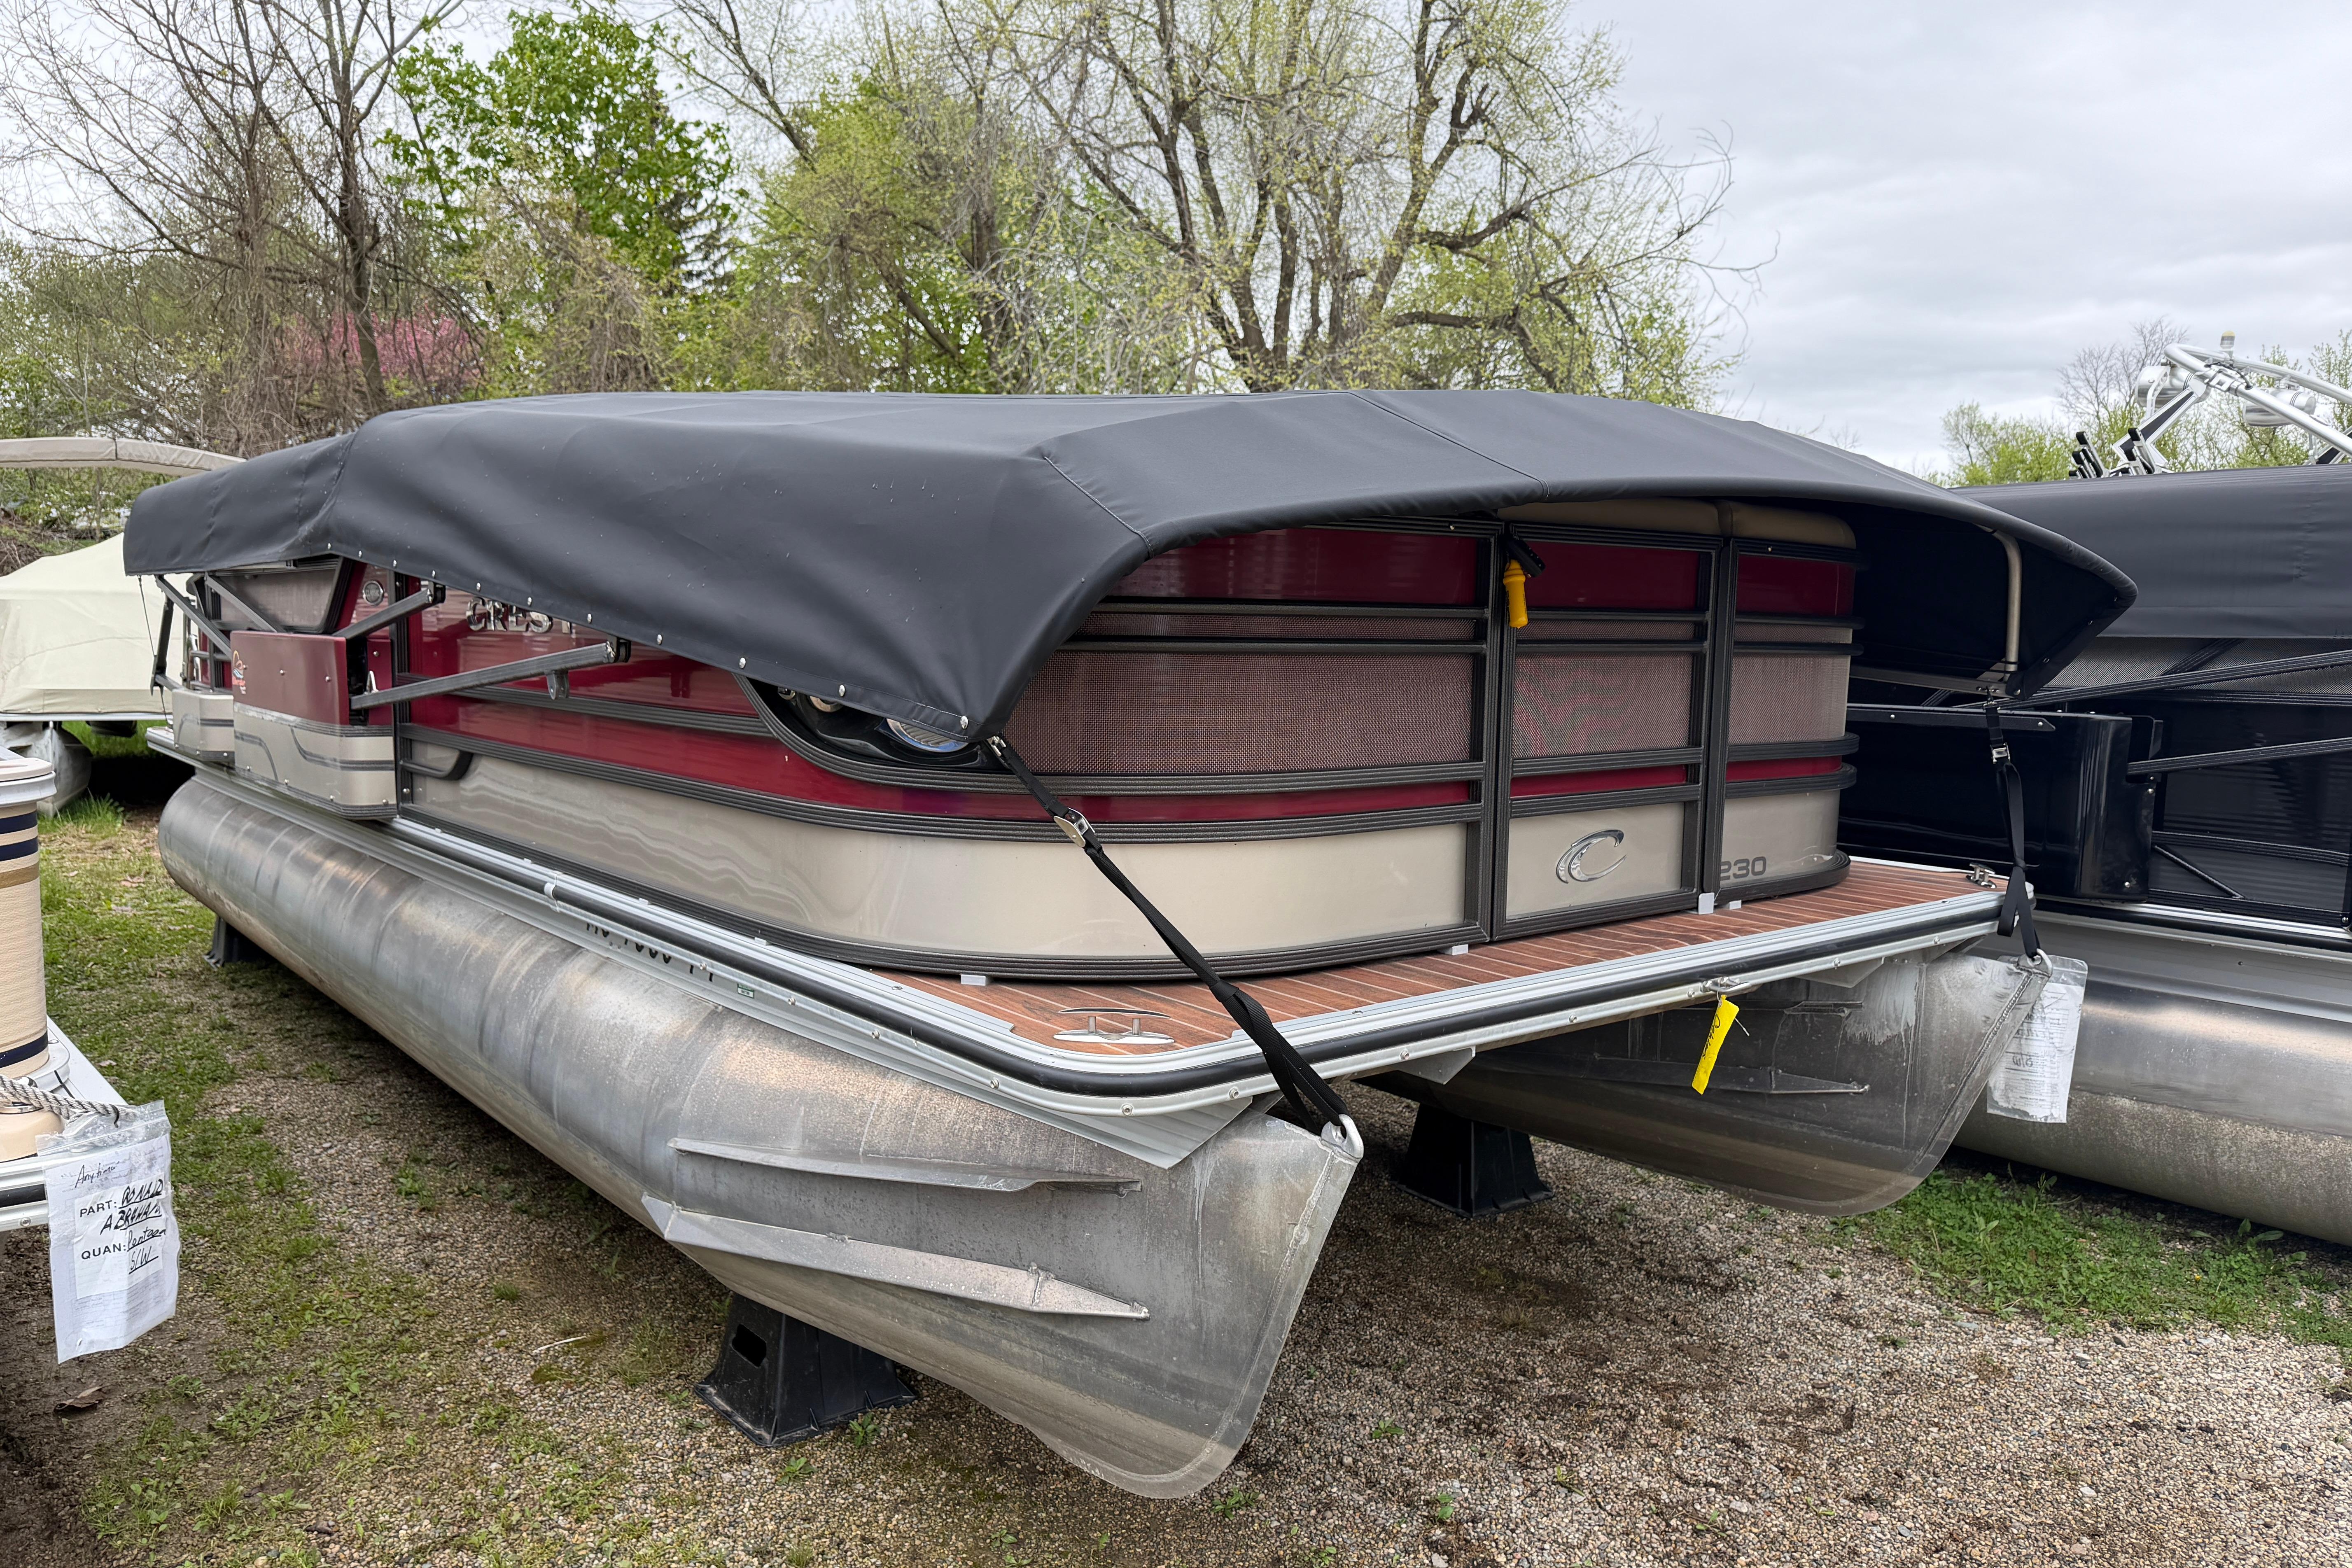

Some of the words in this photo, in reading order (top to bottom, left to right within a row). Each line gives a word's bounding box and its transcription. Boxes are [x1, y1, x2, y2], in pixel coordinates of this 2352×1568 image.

[1720, 856, 1766, 881] 230
[80, 1200, 117, 1218] PART:
[82, 1243, 126, 1260] QUAN:
